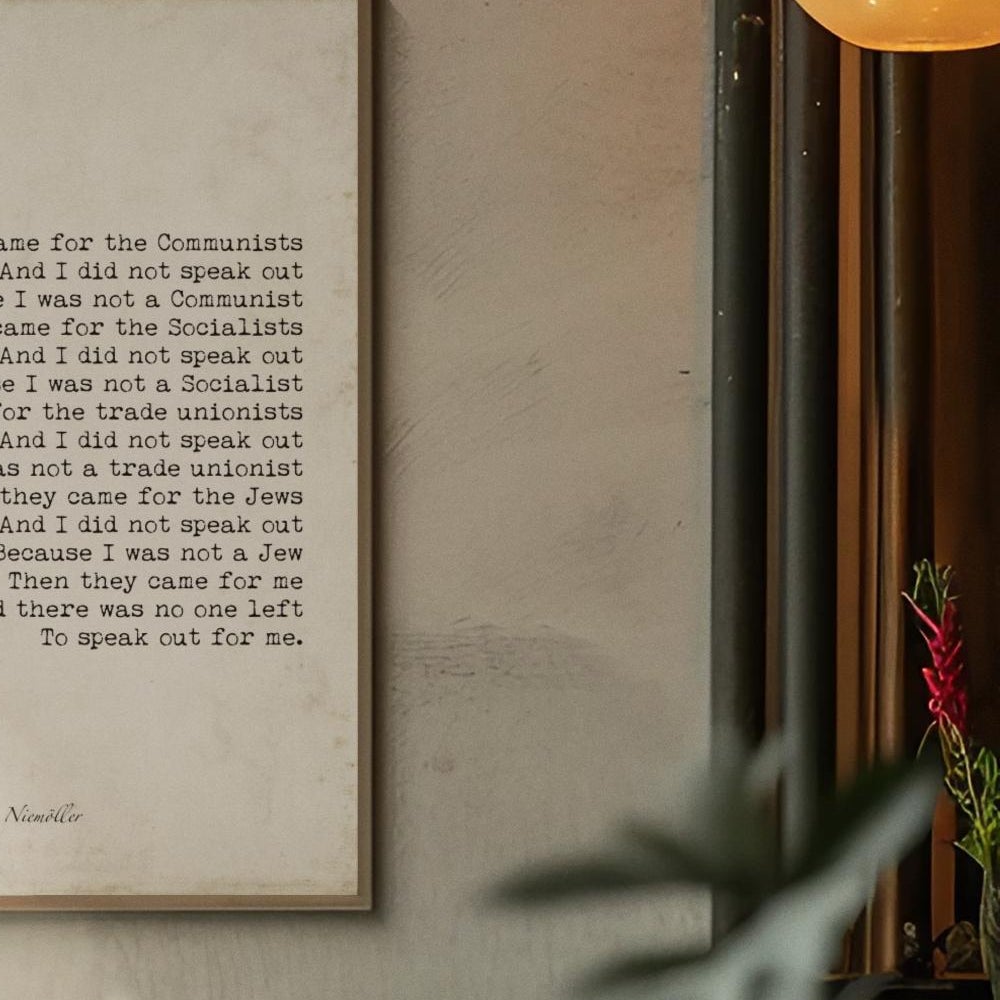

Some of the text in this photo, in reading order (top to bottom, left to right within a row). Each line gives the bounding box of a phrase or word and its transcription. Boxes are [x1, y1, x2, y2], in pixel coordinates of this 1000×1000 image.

[49, 232, 94, 252] for
[104, 232, 148, 252] the
[157, 232, 304, 253] Communists
[55, 261, 68, 281] I
[77, 261, 119, 281] did
[127, 261, 171, 281] not
[180, 261, 252, 284] speak
[261, 261, 304, 281] out
[14, 289, 27, 309] I
[37, 293, 83, 309] was
[92, 289, 135, 309] not
[145, 294, 161, 309] a
[170, 288, 304, 309] Communist
[60, 317, 105, 337] for
[115, 317, 158, 337] the
[167, 317, 304, 337] Socialists
[55, 346, 68, 365] I
[77, 345, 119, 365] did
[127, 345, 171, 365] not
[180, 346, 252, 369] speak
[261, 345, 304, 365] out
[25, 374, 38, 393] I
[48, 378, 93, 393] was
[103, 373, 147, 393] not
[155, 378, 172, 393] a
[181, 373, 304, 393] Socialist
[41, 401, 86, 421] the
[95, 402, 168, 422] trade
[176, 402, 304, 422] unionists
[55, 430, 68, 450] I
[77, 430, 119, 450] did
[127, 430, 171, 450] not
[180, 430, 252, 453] speak
[261, 430, 304, 450] out
[29, 458, 73, 478] not
[82, 463, 99, 478] a
[108, 458, 181, 478] trade
[190, 458, 304, 478] unionist
[0, 486, 57, 510] they
[67, 491, 128, 506] came
[137, 486, 182, 506] for
[192, 486, 236, 506] the
[244, 486, 304, 506] Jews
[55, 515, 68, 534] I
[77, 514, 119, 534] did
[127, 514, 171, 534] not
[180, 515, 252, 538] speak
[261, 514, 304, 534] out
[102, 543, 115, 562] I
[125, 547, 170, 562] was
[179, 542, 223, 562] not
[232, 547, 249, 562] a
[258, 543, 304, 563] Jew
[8, 570, 304, 595] Then they came for me
[16, 599, 89, 619] there
[99, 603, 145, 619] was
[154, 603, 184, 619] no
[193, 603, 238, 619] one
[247, 598, 304, 619] left
[40, 627, 304, 651] To speak out for me.
[4, 802, 84, 823] Niemöller
